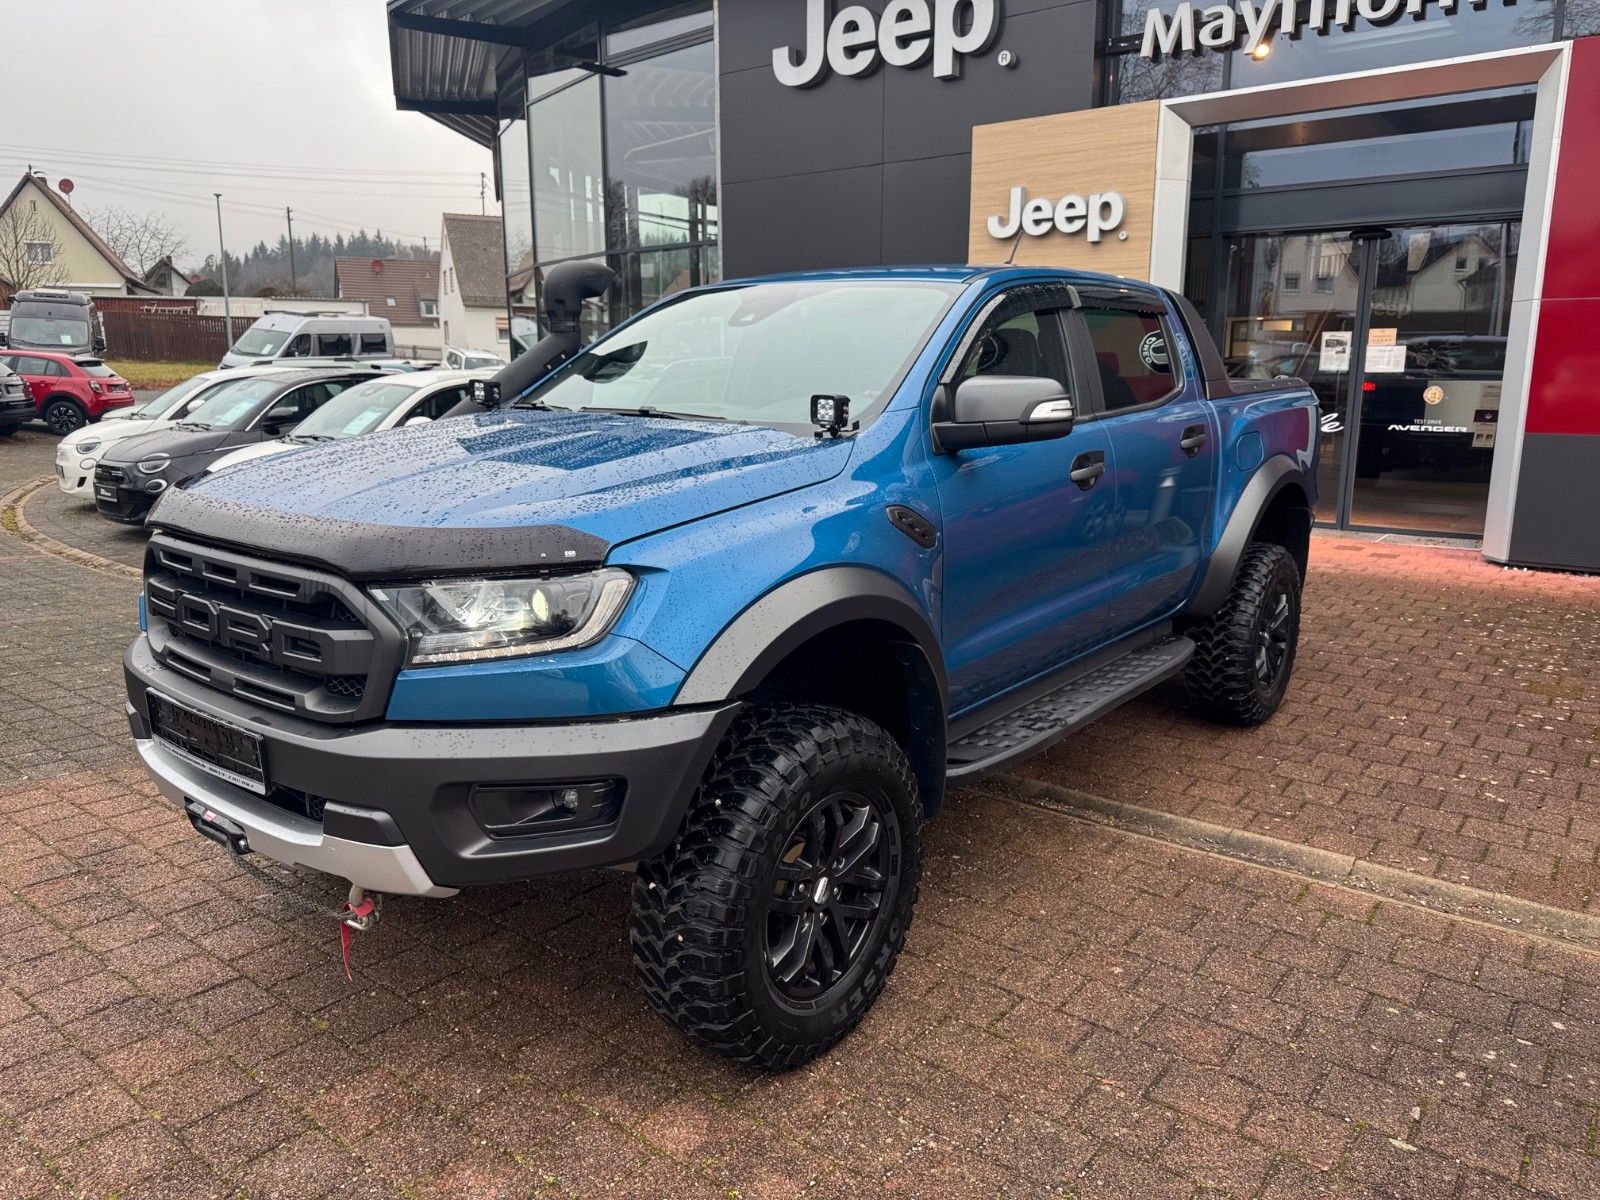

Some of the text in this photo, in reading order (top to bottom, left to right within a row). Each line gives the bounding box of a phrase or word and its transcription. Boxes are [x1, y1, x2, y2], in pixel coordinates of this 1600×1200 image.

[772, 0, 998, 86] Jeep
[987, 185, 1125, 243] Jeep
[1387, 424, 1468, 433] AVENGER
[147, 577, 335, 671] FORD
